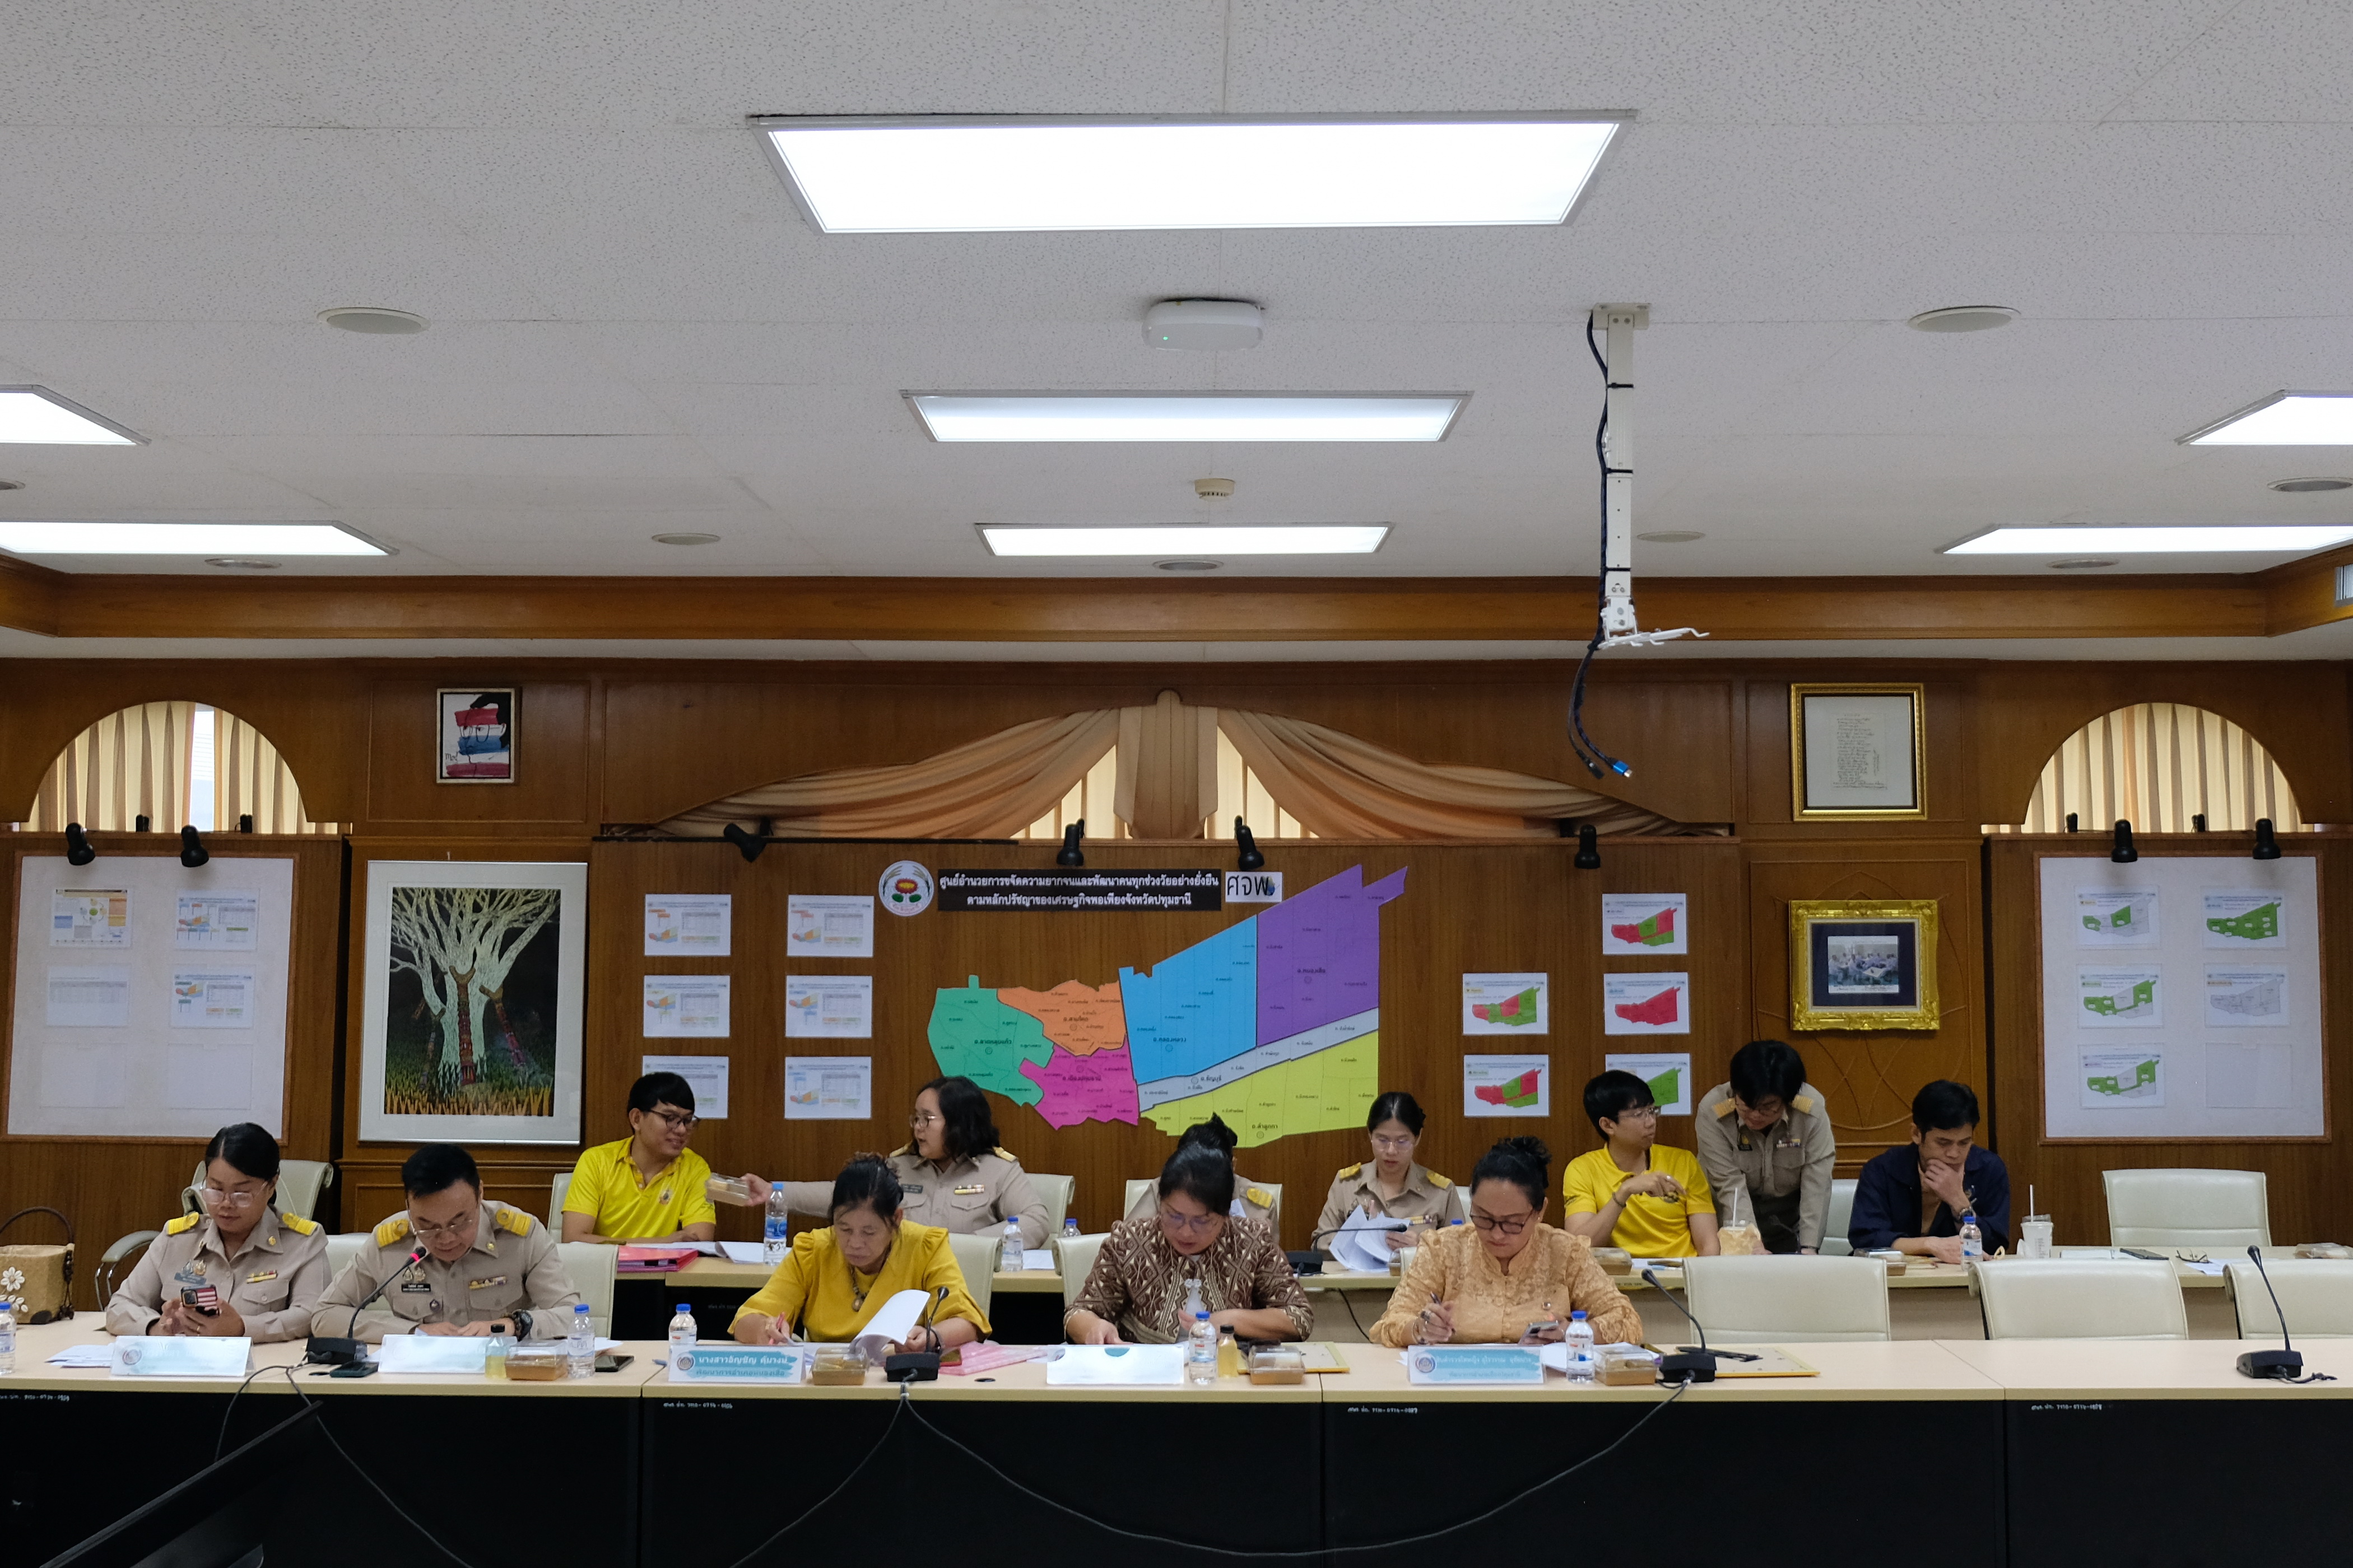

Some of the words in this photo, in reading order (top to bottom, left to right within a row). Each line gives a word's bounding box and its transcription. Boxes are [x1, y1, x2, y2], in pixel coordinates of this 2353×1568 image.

[940, 871, 1219, 890] ศูนย์อำนวยการขจัดความยากจนและพัฒนาคนทุกช่วงวัยอย่างยั่งยืน
[1227, 874, 1270, 896] ศจพ
[966, 892, 1192, 908] ตามหลักปรัชญาของเศรษฐกิจพอเพียงจังหวัดปทุมธานี
